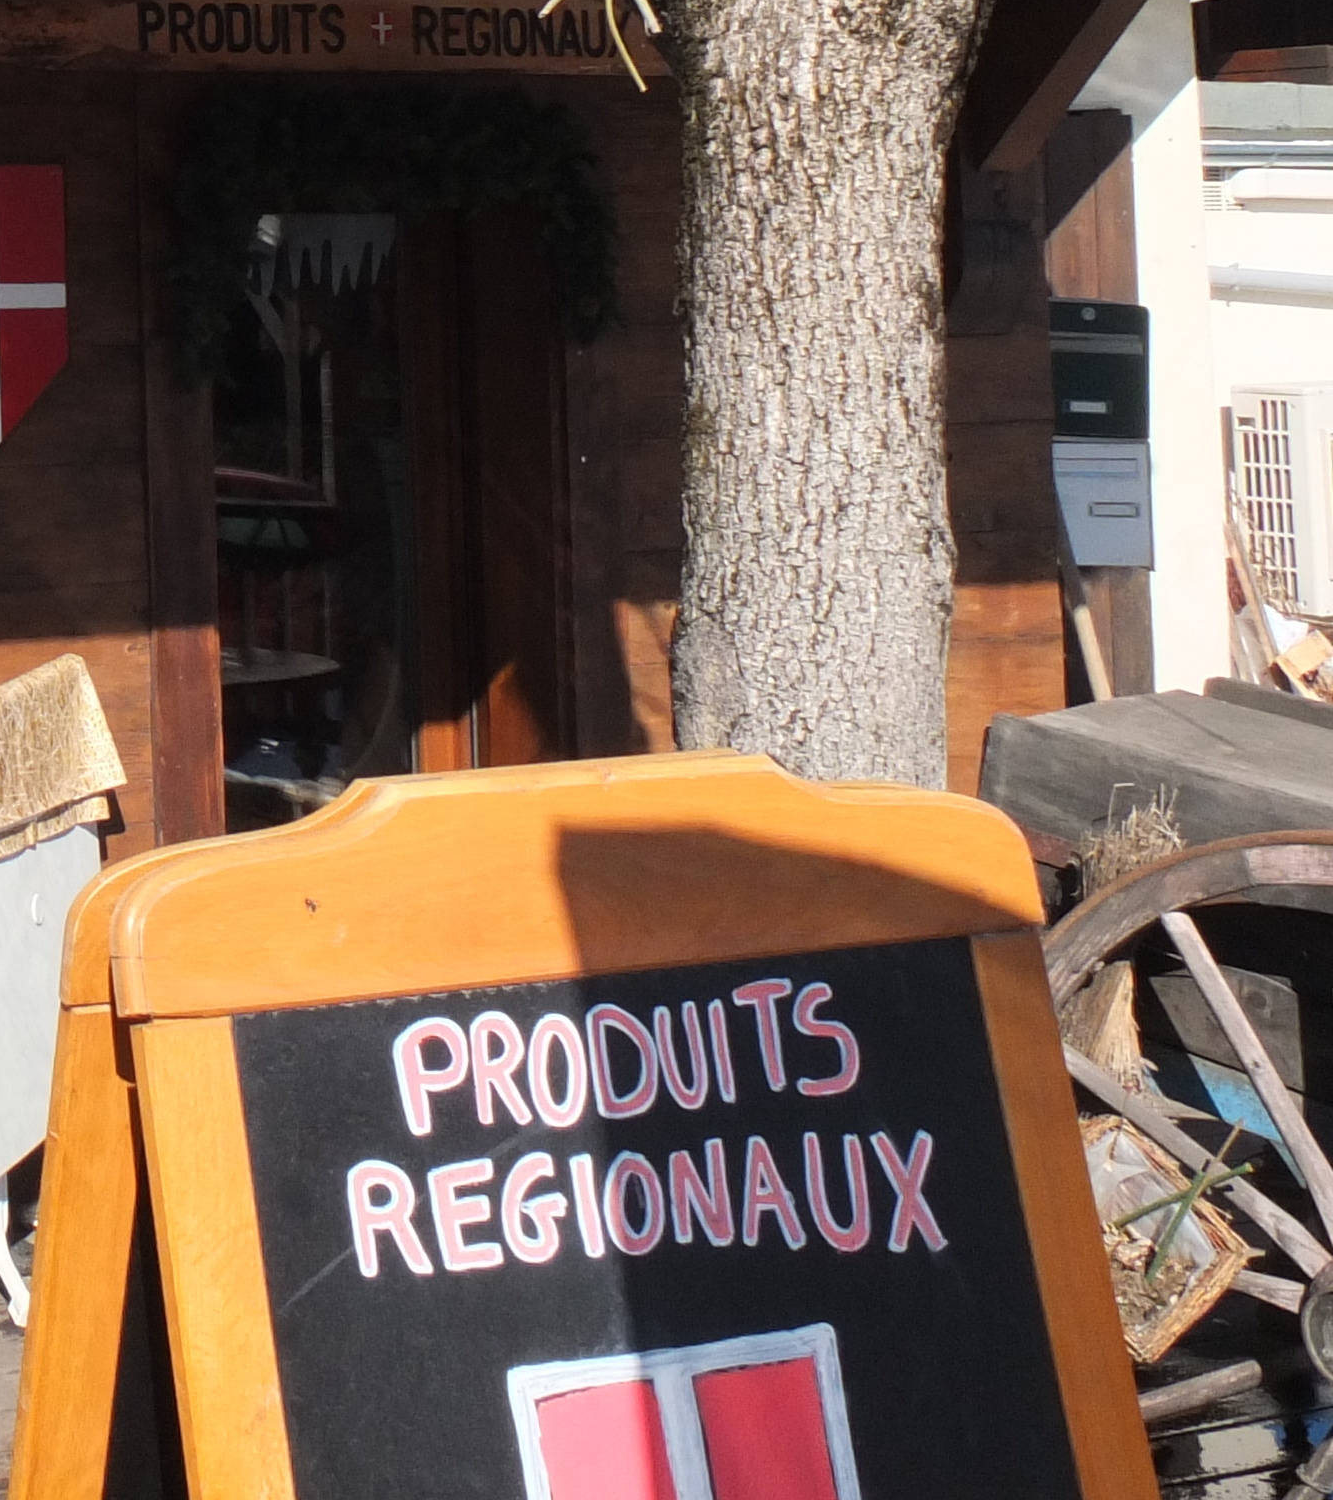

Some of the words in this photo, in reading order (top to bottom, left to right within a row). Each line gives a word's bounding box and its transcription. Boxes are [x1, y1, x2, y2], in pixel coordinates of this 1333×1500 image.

[136, 1, 346, 57] PRODUITS
[393, 977, 861, 1137] PRODUITS
[345, 1127, 951, 1280] REGIONAUX
